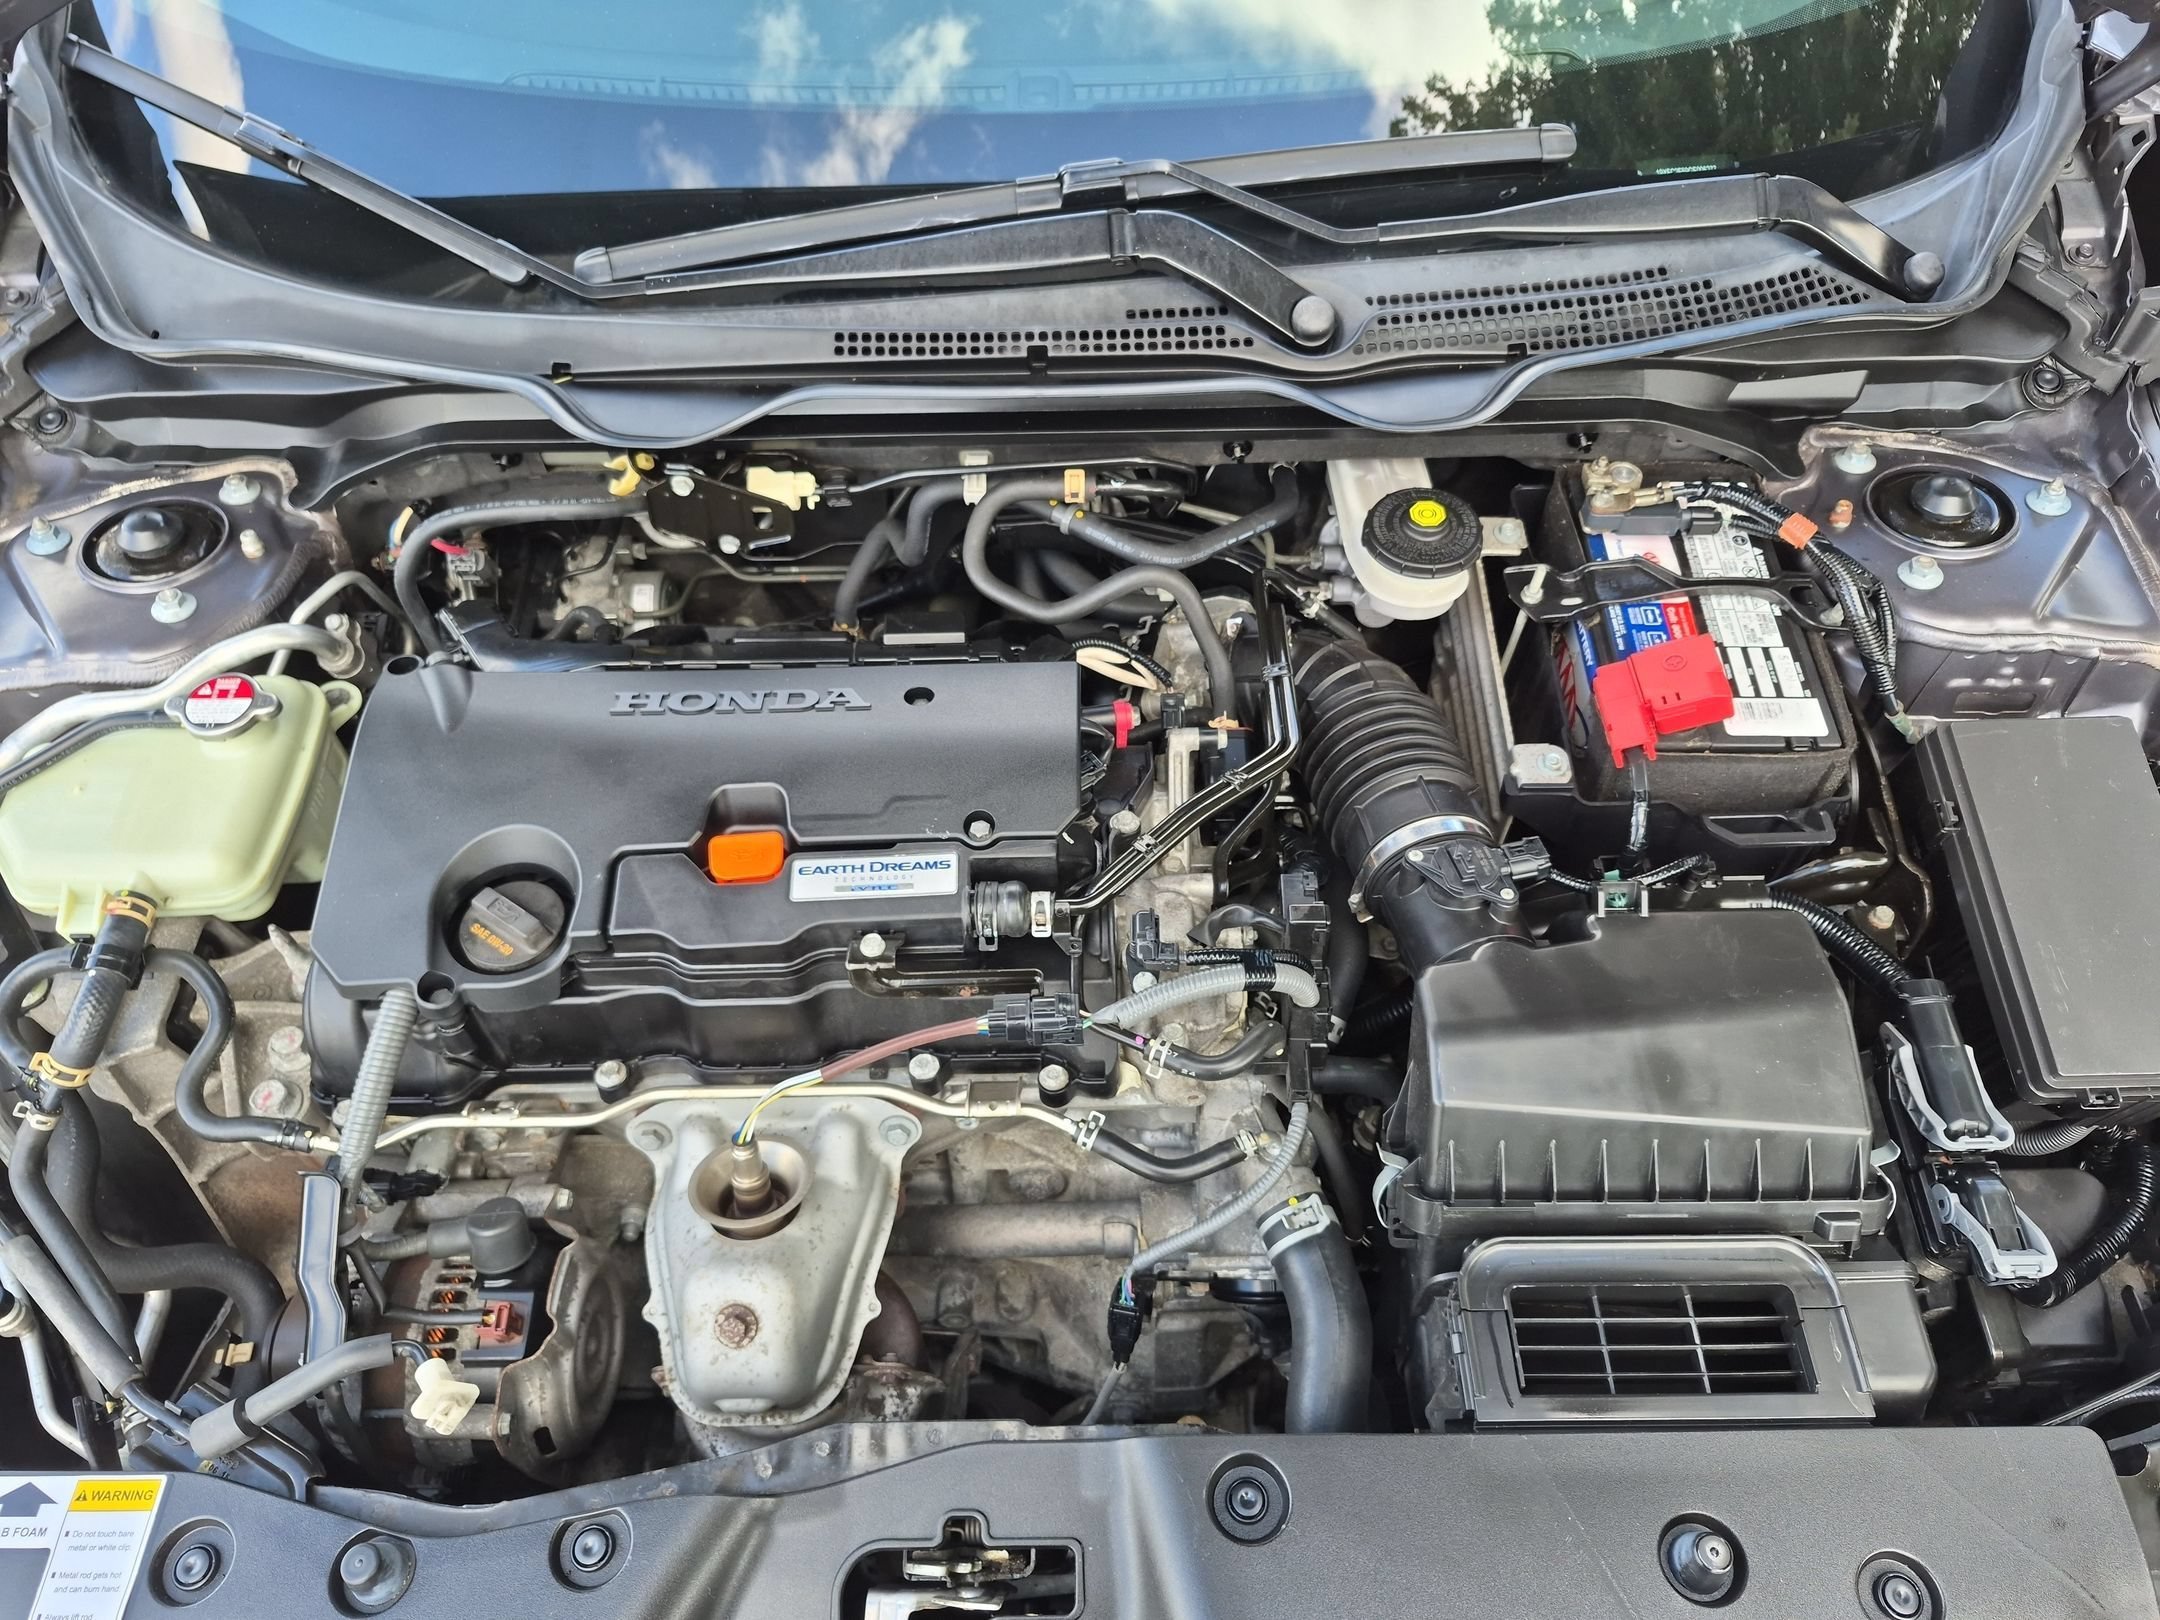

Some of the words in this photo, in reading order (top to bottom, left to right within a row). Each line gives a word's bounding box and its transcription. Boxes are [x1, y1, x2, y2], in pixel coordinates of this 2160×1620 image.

[609, 687, 872, 715] HONDA
[798, 864, 864, 876] EARTH
[869, 860, 951, 873] DREAMS
[835, 874, 915, 883] TECHNOLOGY
[471, 922, 491, 940] SAE
[487, 934, 514, 957] 0W-20
[91, 1490, 154, 1501] WARNING
[0, 1528, 10, 1537] B
[12, 1528, 48, 1537] FOAM
[72, 1530, 83, 1538] Do
[68, 1544, 88, 1552] metal
[98, 1544, 117, 1552] white
[59, 1571, 79, 1579] Metal
[80, 1571, 92, 1579] rod
[92, 1572, 108, 1581] gets
[110, 1571, 122, 1579] hot
